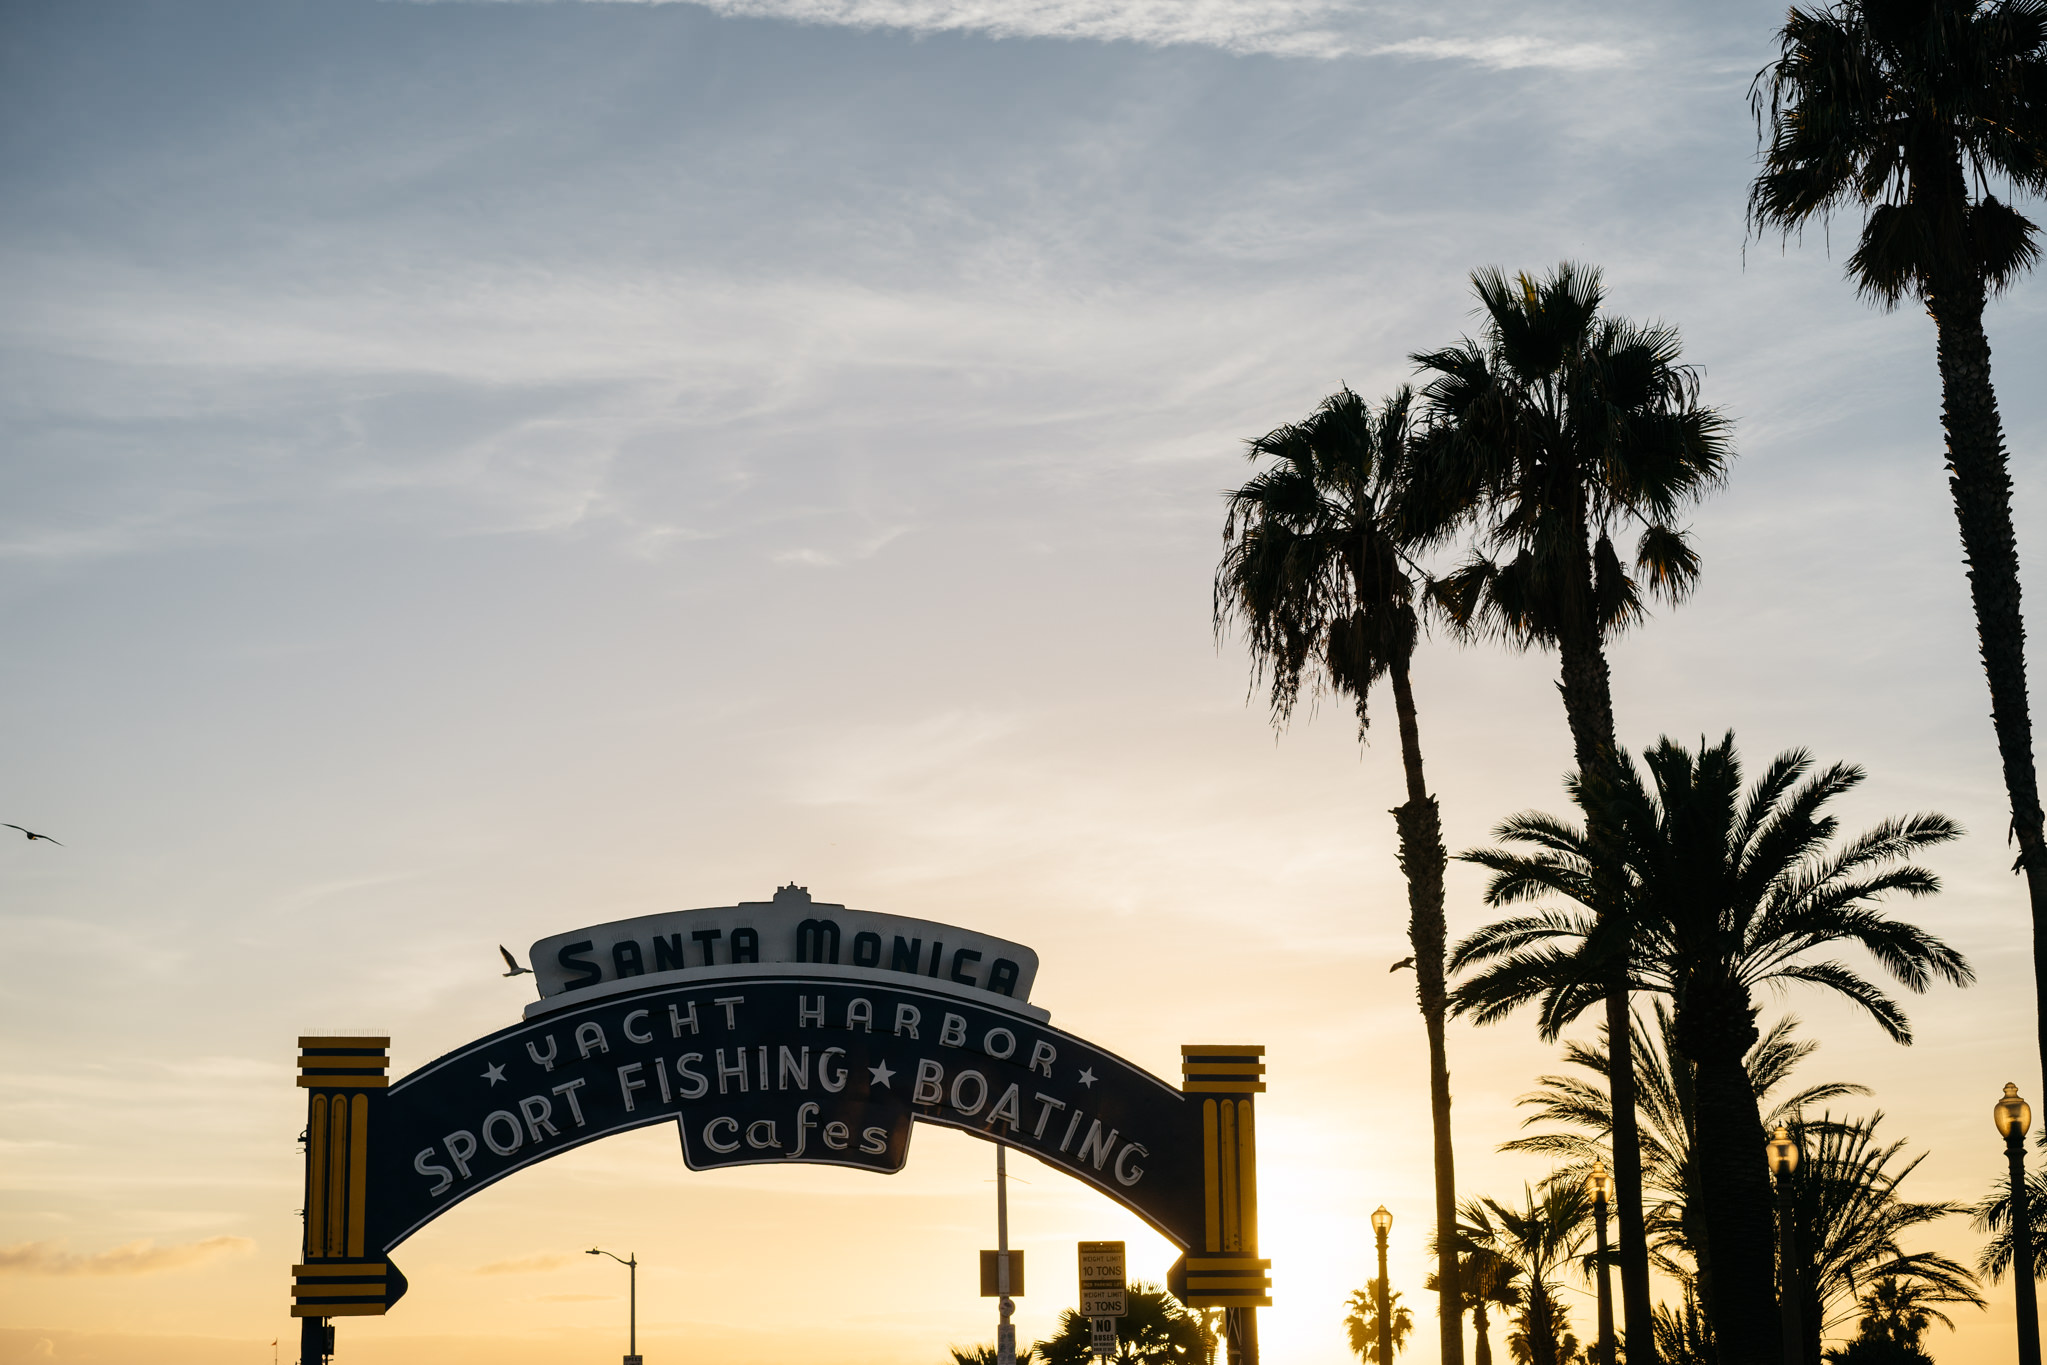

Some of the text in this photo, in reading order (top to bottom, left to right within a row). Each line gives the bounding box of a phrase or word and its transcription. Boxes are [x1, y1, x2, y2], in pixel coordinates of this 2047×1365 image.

[557, 918, 1020, 998] SANTA MONICA
[525, 994, 1057, 1078] YACHT HARBOR
[413, 1044, 1150, 1198] SPORT FISHING BOATING
[702, 1101, 888, 1159] cafes
[1083, 1266, 1121, 1276] 10 TONS
[1085, 1301, 1122, 1311] 3 TONS
[1096, 1320, 1111, 1332] NO
